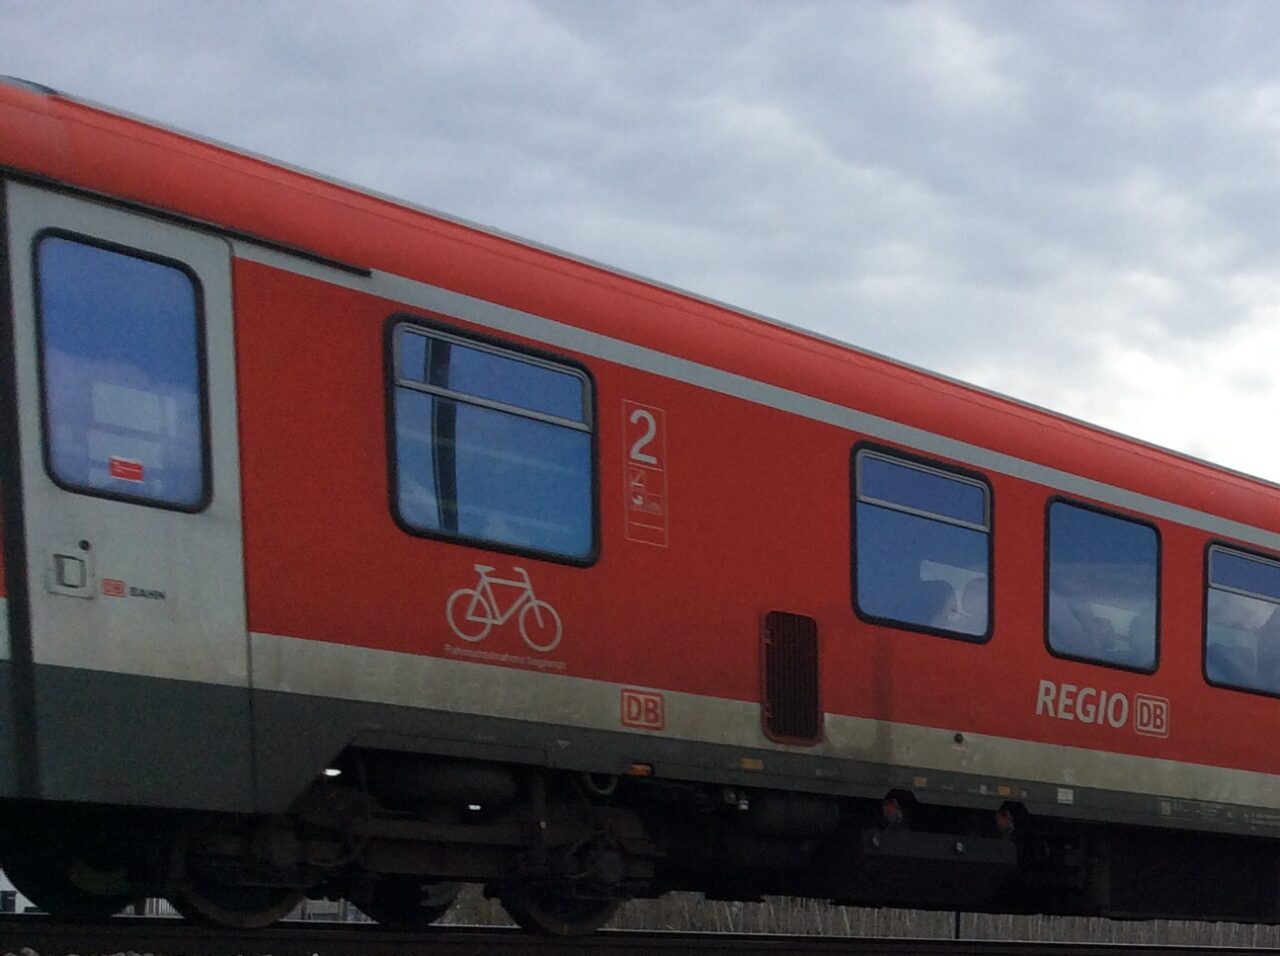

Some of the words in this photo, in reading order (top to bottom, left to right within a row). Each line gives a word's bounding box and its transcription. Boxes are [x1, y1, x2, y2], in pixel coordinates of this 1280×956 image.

[630, 409, 657, 464] 2
[624, 693, 660, 726] DB
[1035, 679, 1129, 729] REGIO
[1138, 699, 1166, 732] DB
